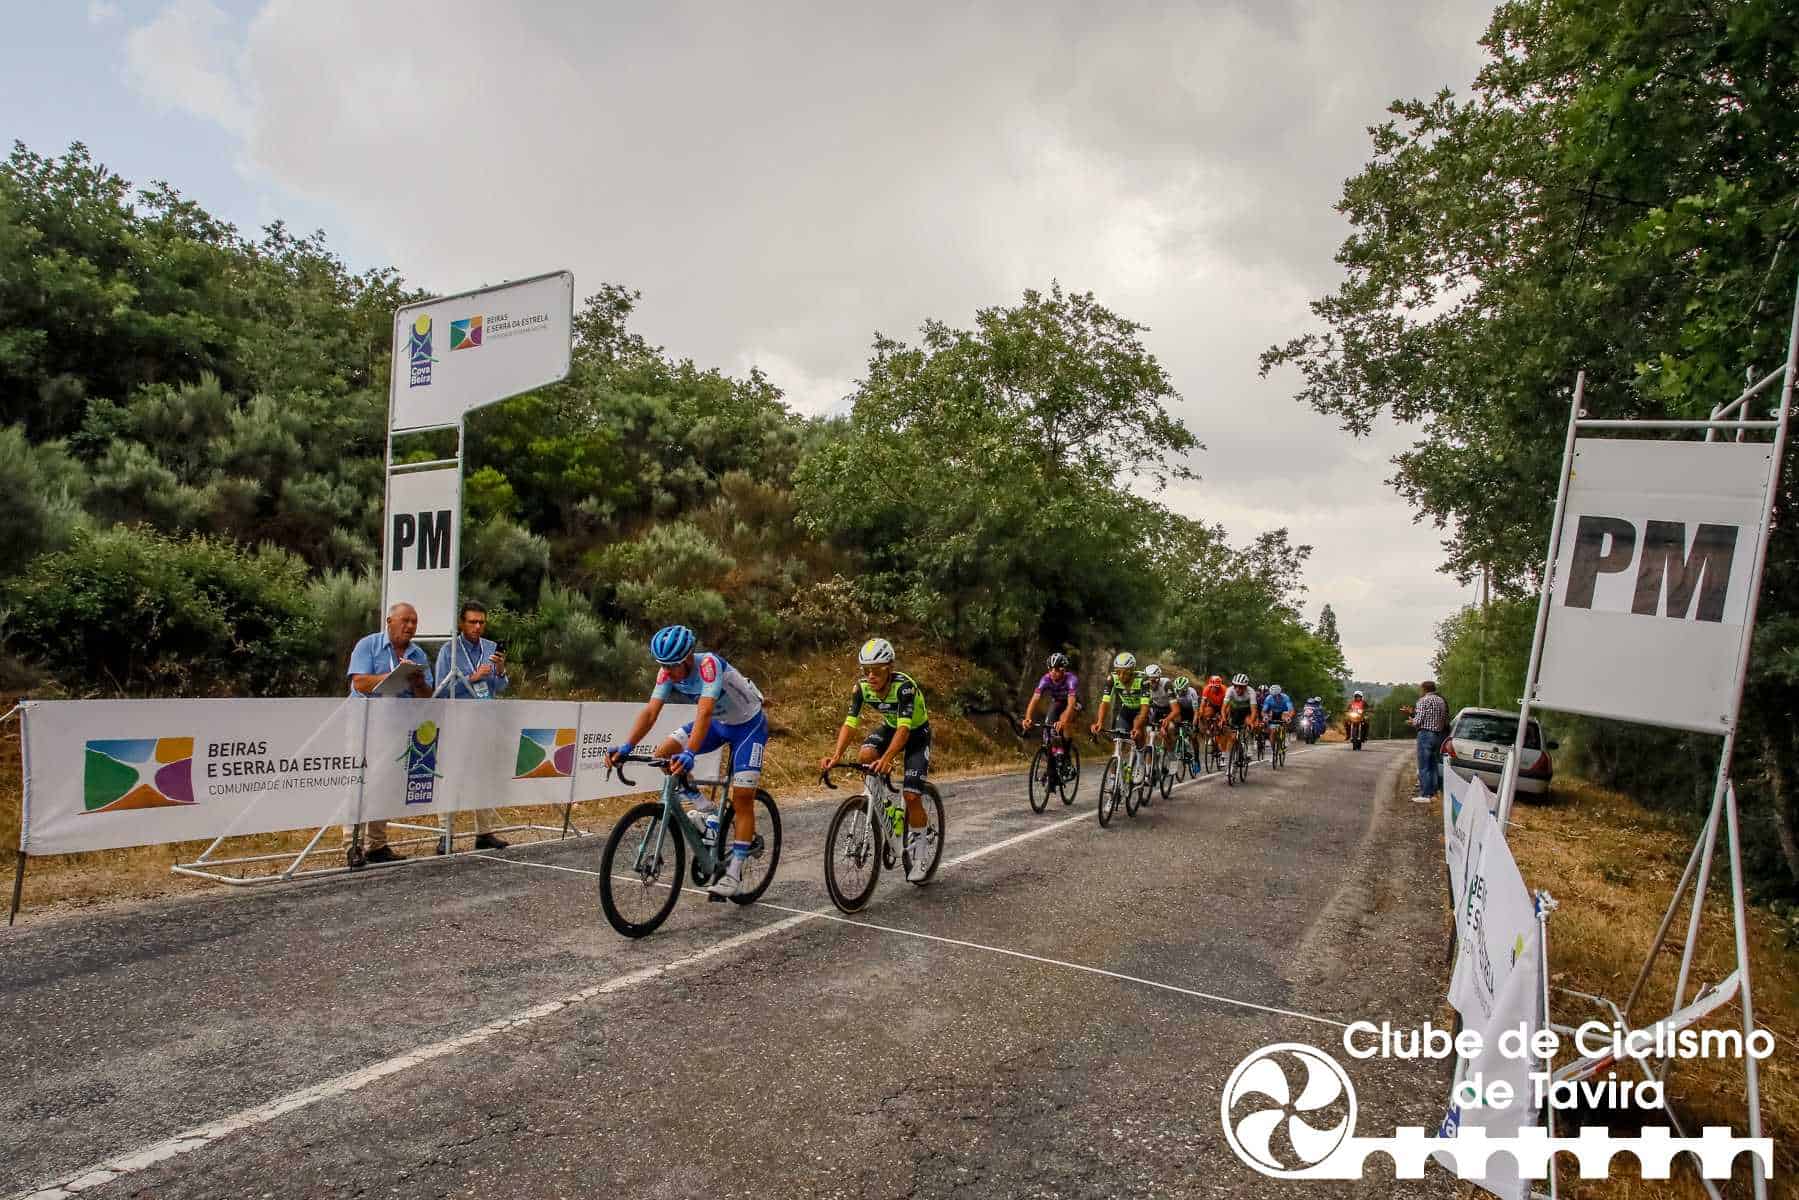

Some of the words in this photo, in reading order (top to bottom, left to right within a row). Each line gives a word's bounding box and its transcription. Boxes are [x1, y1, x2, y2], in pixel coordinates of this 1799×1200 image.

[521, 313, 549, 327] ESTRELA
[411, 367, 431, 376] Cova
[392, 510, 451, 572] PM
[1564, 515, 1740, 623] PM
[583, 733, 613, 744] BEIRAS
[208, 740, 268, 758] BEIRAS
[581, 747, 588, 759] E
[588, 746, 608, 759] SERR
[207, 763, 218, 778] E
[222, 759, 276, 777] SERRA
[279, 758, 300, 773] DA
[303, 756, 369, 771] ESTRELA
[208, 780, 280, 796] COMUNIDADE
[408, 780, 432, 791] Cova
[407, 789, 432, 801] Beira
